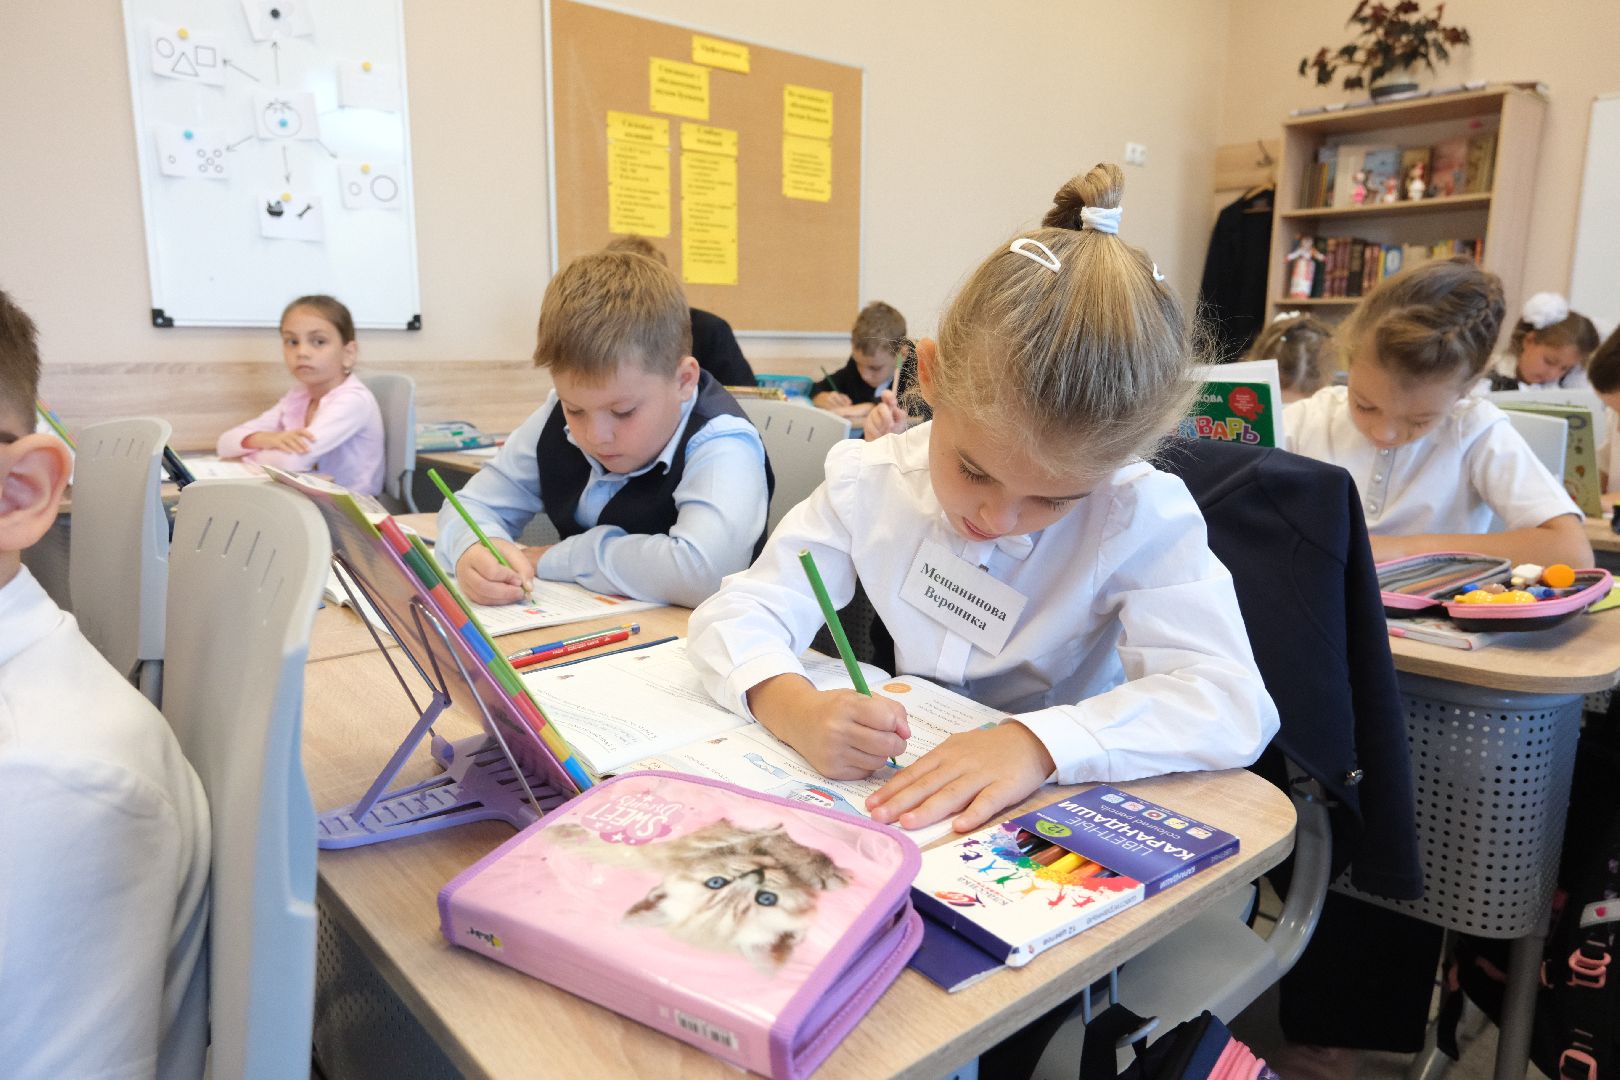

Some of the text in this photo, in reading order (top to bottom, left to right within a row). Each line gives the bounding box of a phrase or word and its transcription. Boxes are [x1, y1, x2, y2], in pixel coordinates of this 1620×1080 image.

[920, 562, 1007, 621] Мещанинова
[924, 585, 987, 630] Вероника
[585, 803, 668, 837] SWEET
[1047, 824, 1066, 834] 12
[1100, 804, 1137, 820] pencils
[1131, 819, 1181, 840] coloured
[1057, 801, 1196, 861] КАРАНДАШИ
[1064, 816, 1154, 856] ЦВЕТНЫЕ
